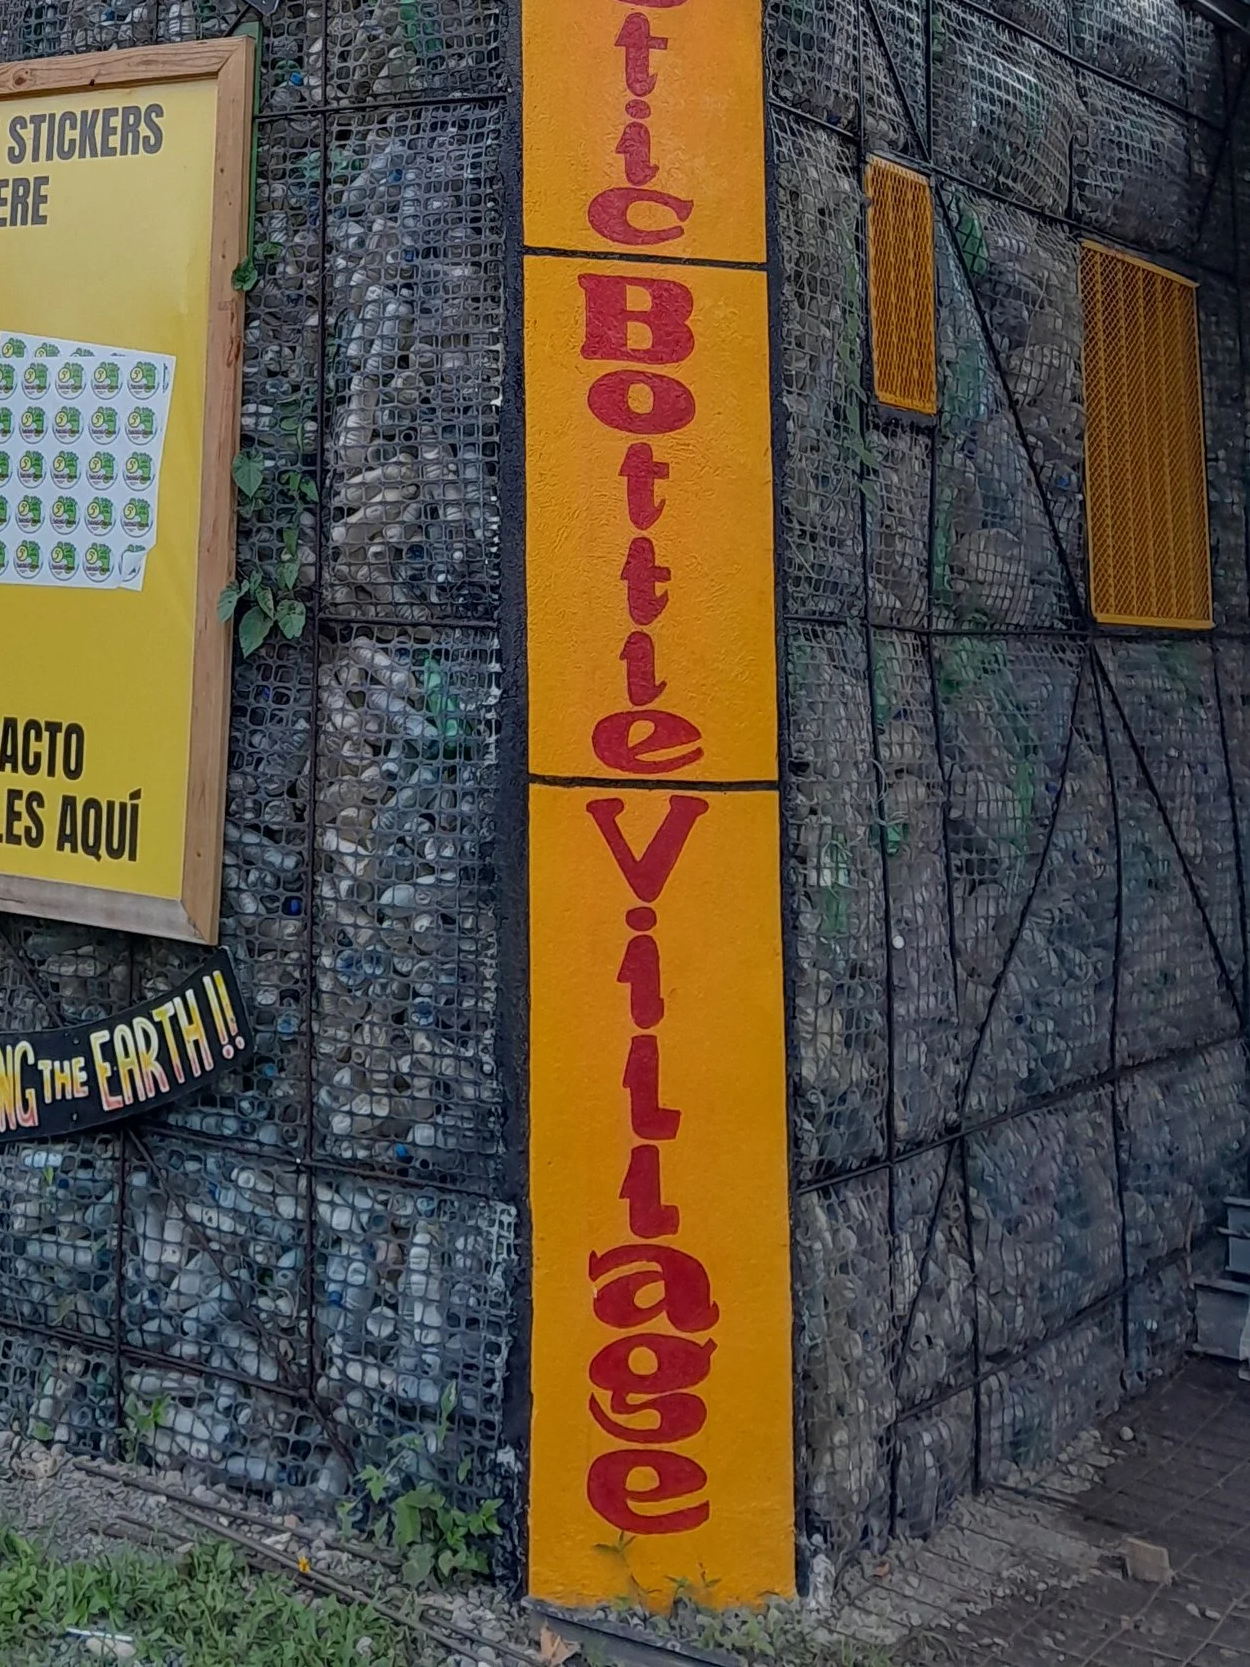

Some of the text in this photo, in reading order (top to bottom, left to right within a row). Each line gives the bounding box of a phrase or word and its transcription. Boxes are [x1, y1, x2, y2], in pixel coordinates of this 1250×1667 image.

[6, 103, 165, 165] STICKERS
[577, 272, 706, 777] Bottle
[56, 788, 142, 863] AQUÍ
[37, 1056, 89, 1103] THE
[90, 989, 217, 1111] EARTH
[583, 794, 722, 1536] Village
